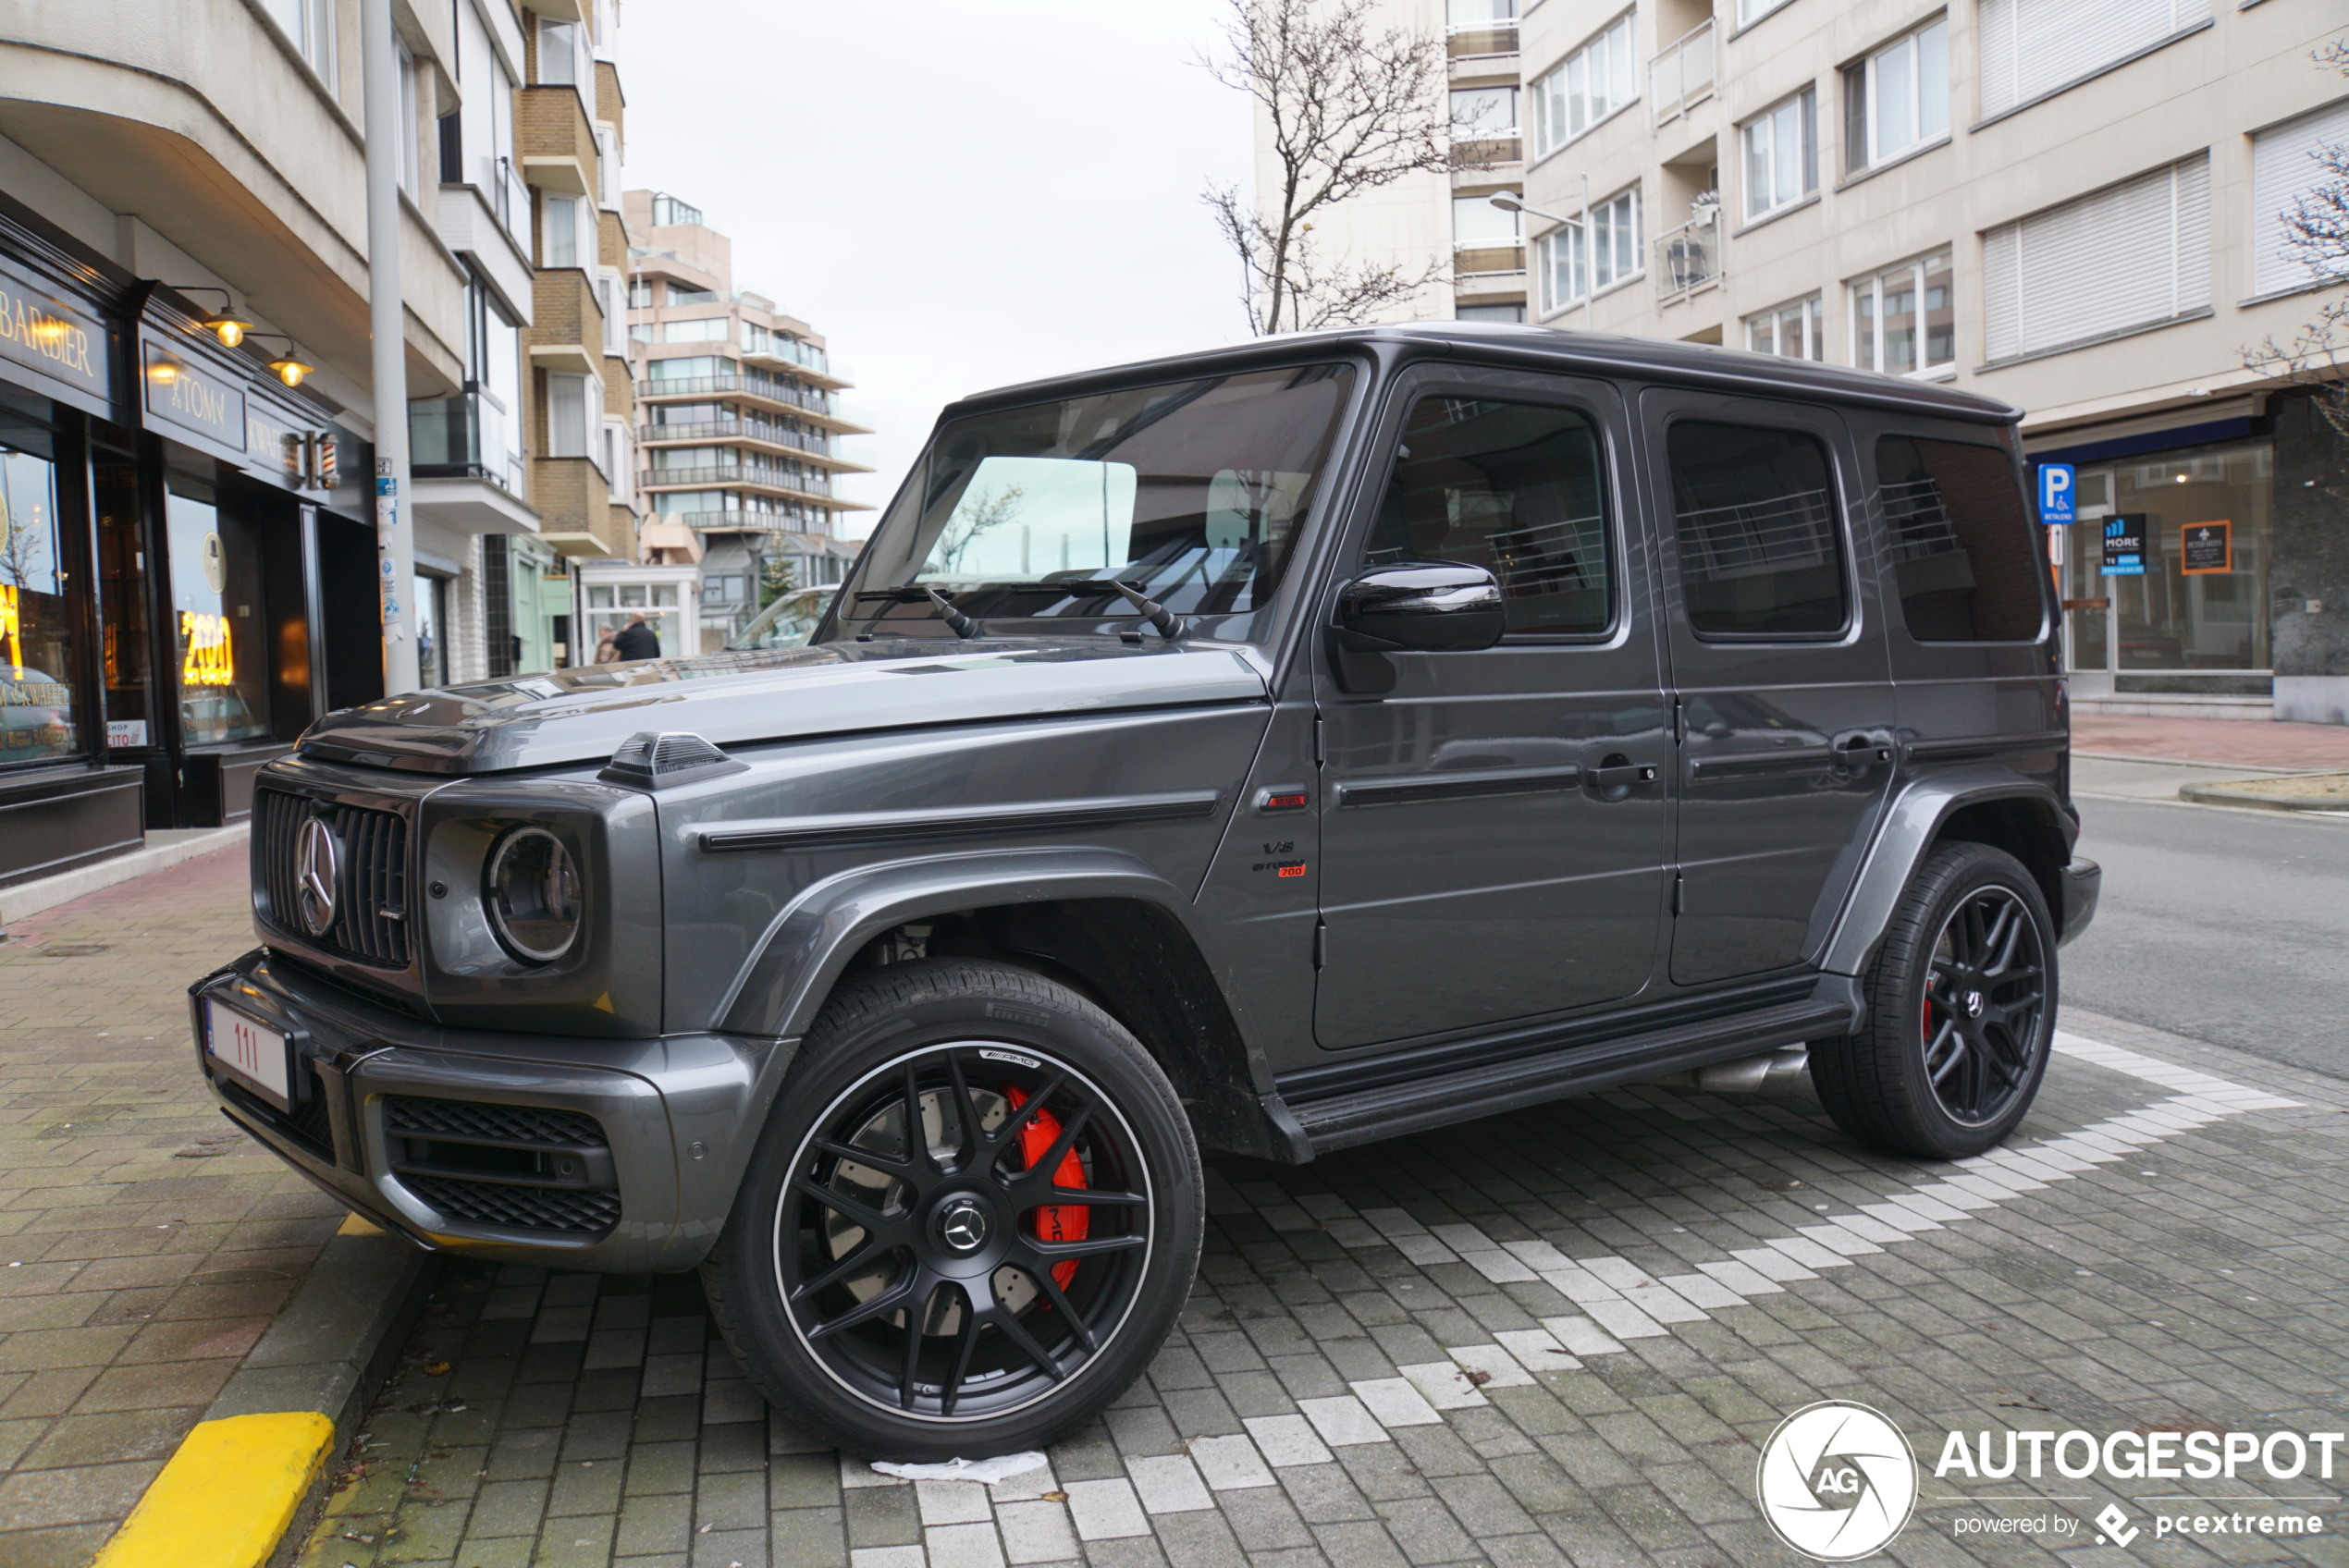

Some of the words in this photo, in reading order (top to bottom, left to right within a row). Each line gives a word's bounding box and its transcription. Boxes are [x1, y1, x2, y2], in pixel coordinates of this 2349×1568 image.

[180, 375, 217, 425] TOM
[2046, 468, 2070, 508] P
[2106, 537, 2140, 547] MORE
[1262, 840, 1294, 854] V8
[1281, 867, 1302, 876] 700
